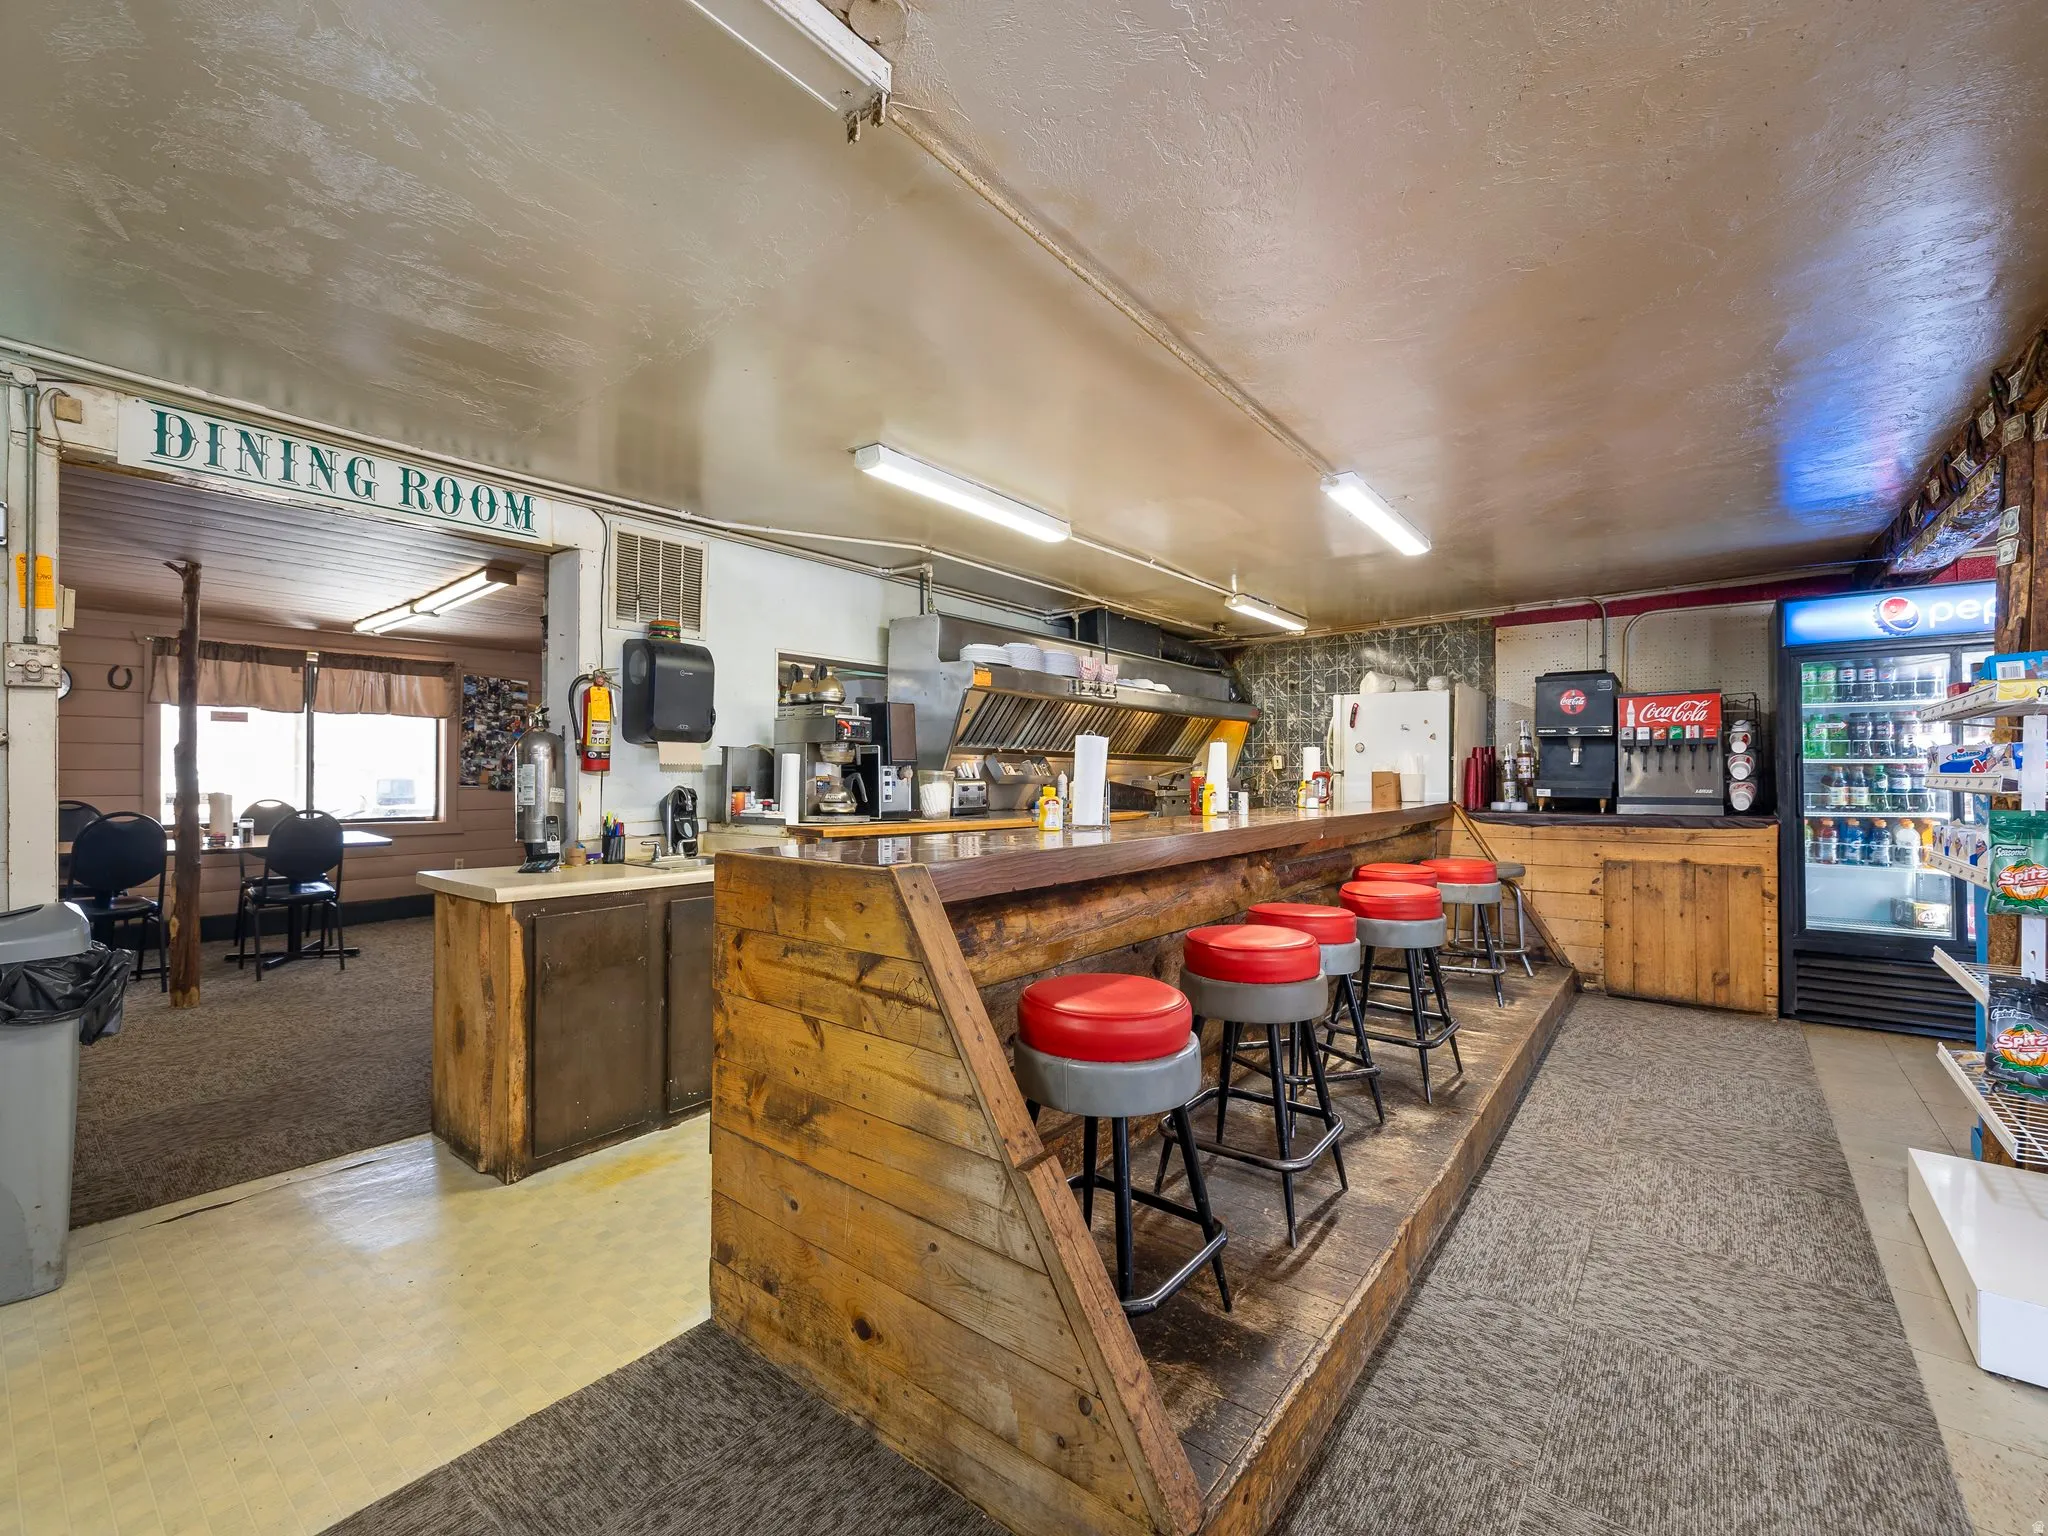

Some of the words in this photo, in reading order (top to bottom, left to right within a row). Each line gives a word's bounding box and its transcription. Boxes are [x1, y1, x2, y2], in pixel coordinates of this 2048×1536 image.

[151, 409, 379, 501] DINING
[398, 466, 537, 533] ROOM
[1639, 700, 1711, 723] Coca-Cola
[1951, 750, 1981, 760] Hostess
[1995, 846, 2028, 858] Seasoned
[1997, 867, 2048, 888] Spitz
[1993, 1032, 2048, 1051] Spitz
